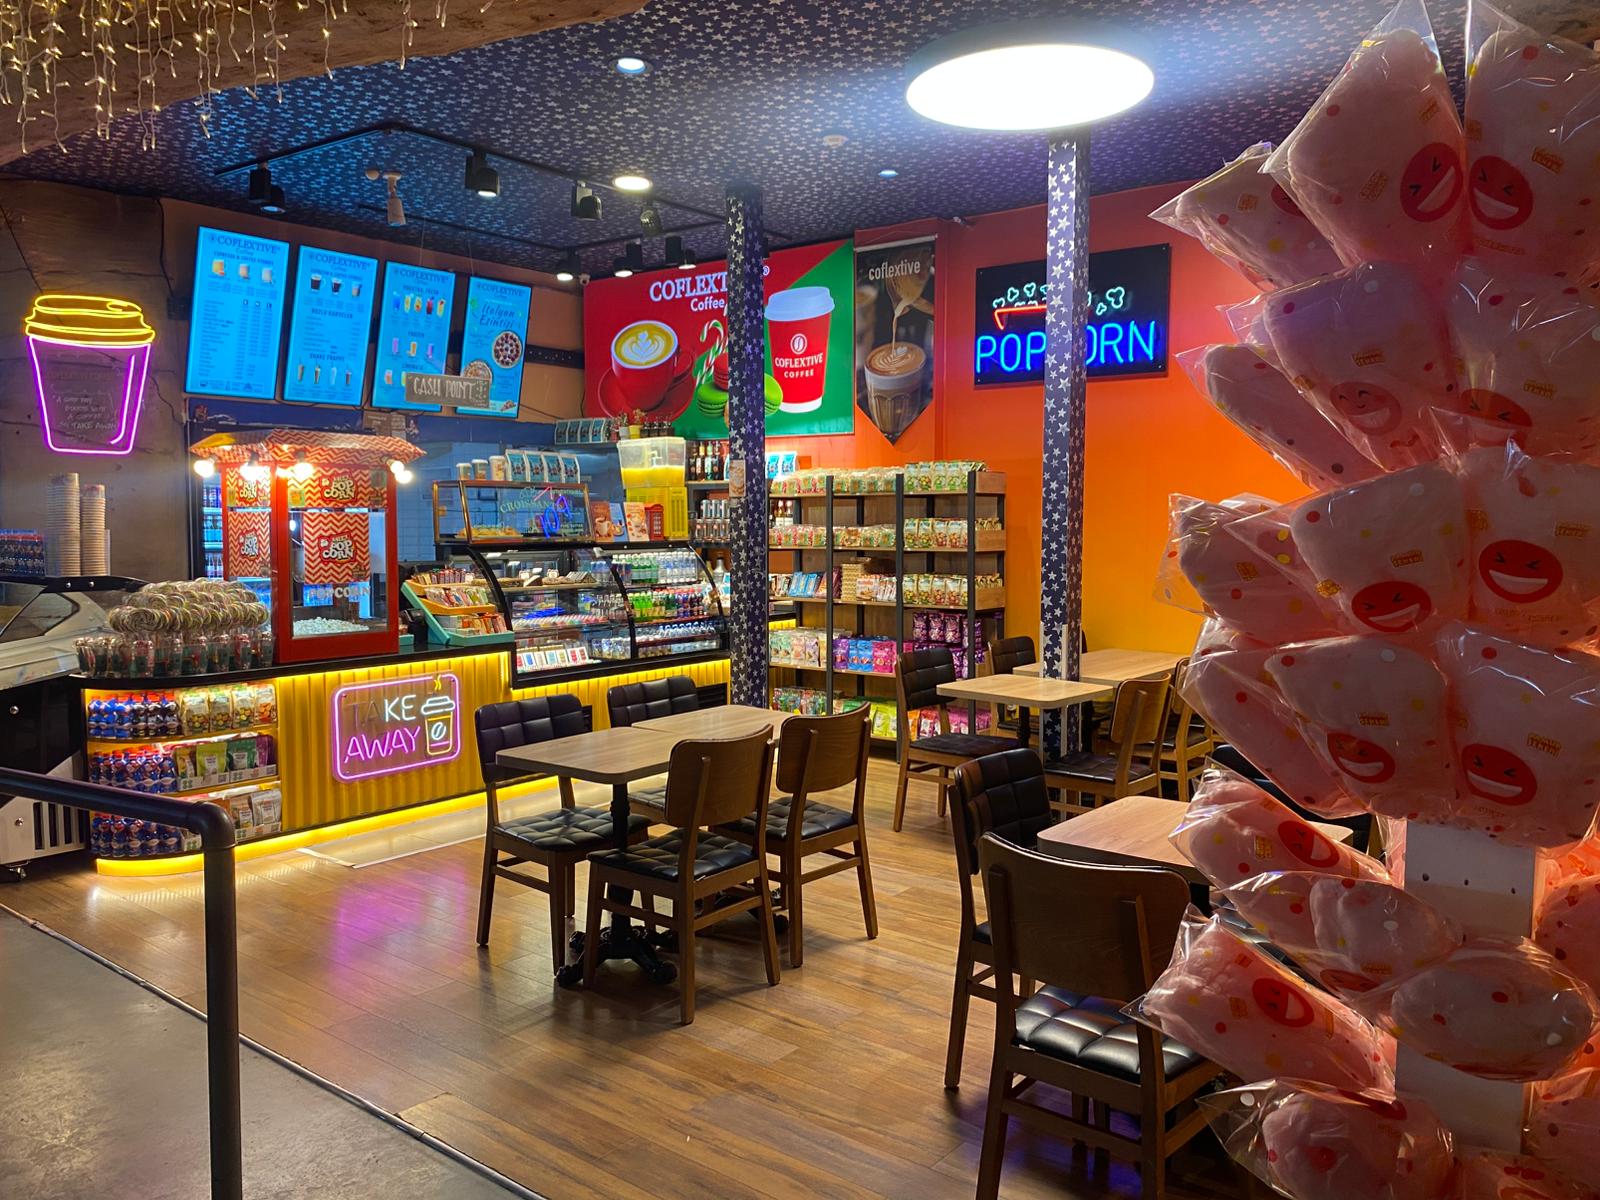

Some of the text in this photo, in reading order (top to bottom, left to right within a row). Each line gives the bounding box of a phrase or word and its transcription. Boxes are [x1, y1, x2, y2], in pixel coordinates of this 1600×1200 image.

[868, 259, 921, 281] coflextive
[690, 296, 725, 312] Coffee
[774, 352, 824, 368] COFLEXTIVE
[783, 368, 814, 379] COFFEE
[413, 377, 441, 396] CASH
[445, 381, 475, 400] POINT
[323, 488, 355, 499] CORN
[322, 549, 354, 560] CORN
[344, 726, 420, 764] AWAY
